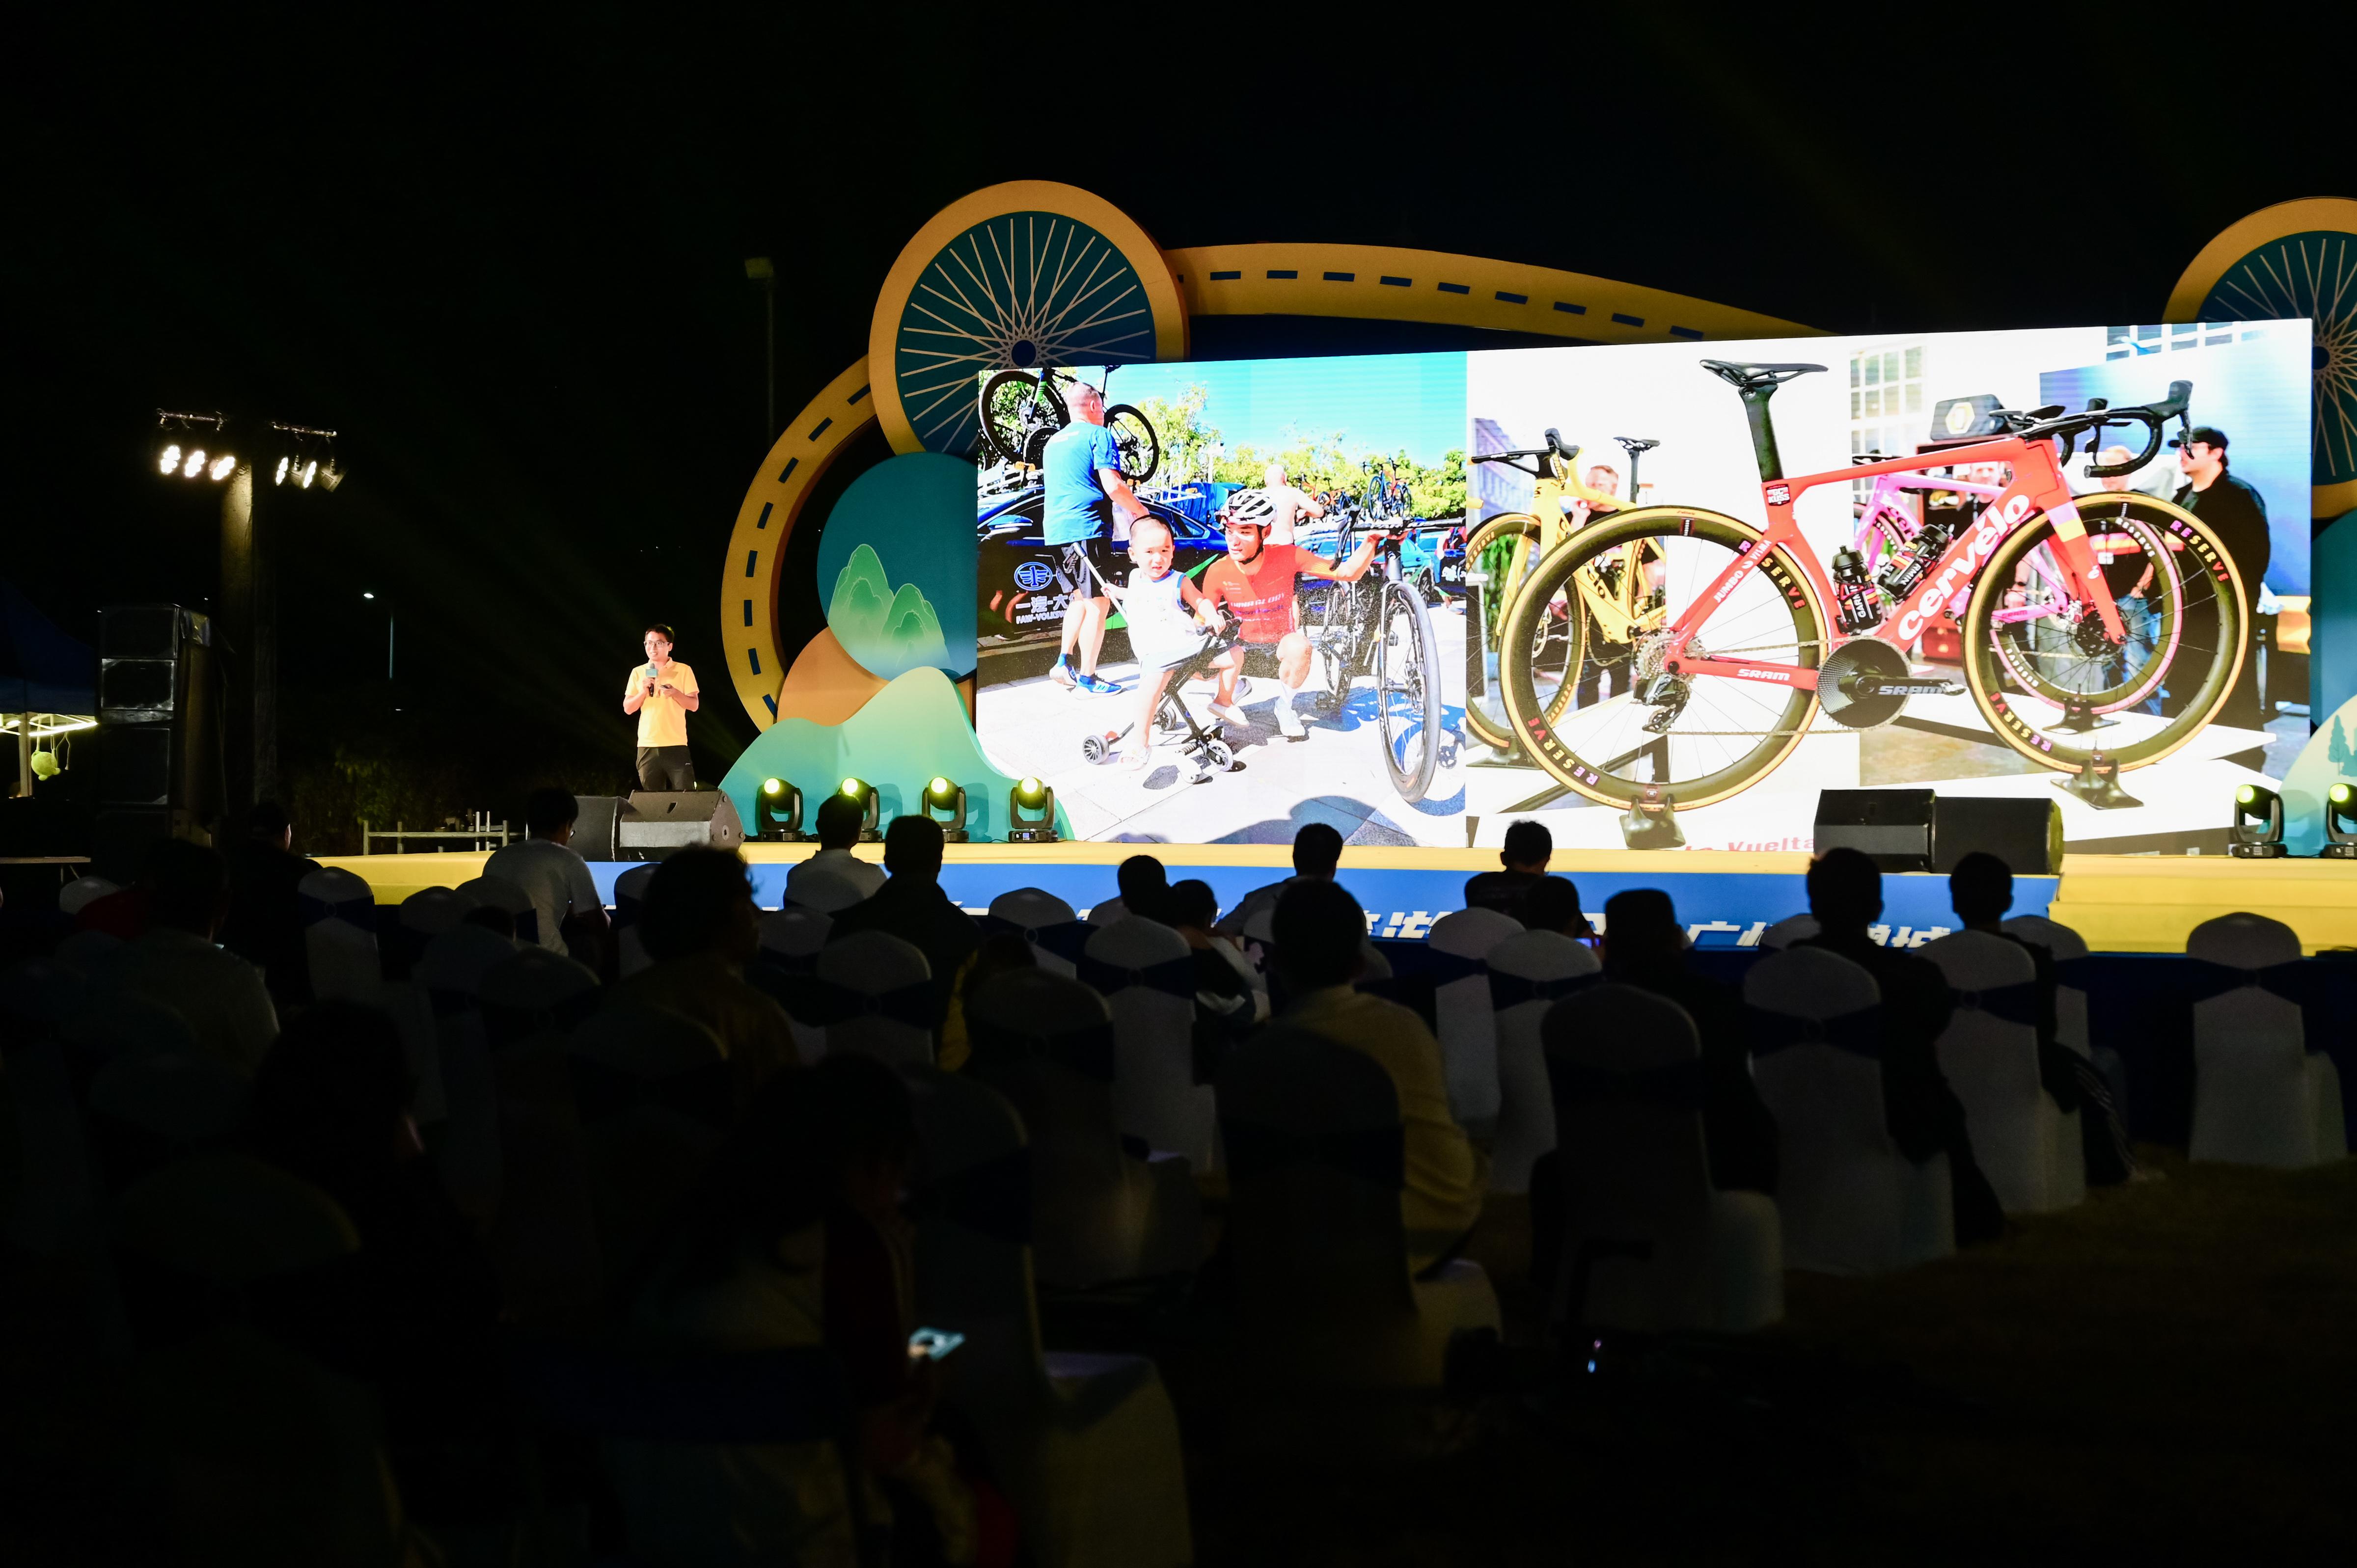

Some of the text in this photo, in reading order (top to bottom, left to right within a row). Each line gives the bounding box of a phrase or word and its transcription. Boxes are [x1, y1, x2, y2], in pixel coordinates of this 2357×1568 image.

[1768, 493, 1790, 503] KUSS
[1713, 540, 1772, 604] JUMBO VISMA
[1738, 540, 1806, 609] RSERVE
[1898, 495, 2029, 640] cervélo
[2170, 520, 2229, 582] RESERVE
[1737, 669, 1790, 681] SRAM
[1878, 685, 1944, 695] SRAM
[1528, 717, 1599, 785] RESERVE
[1990, 692, 2052, 752] RESERVE
[1728, 837, 1814, 852] Vuelta
